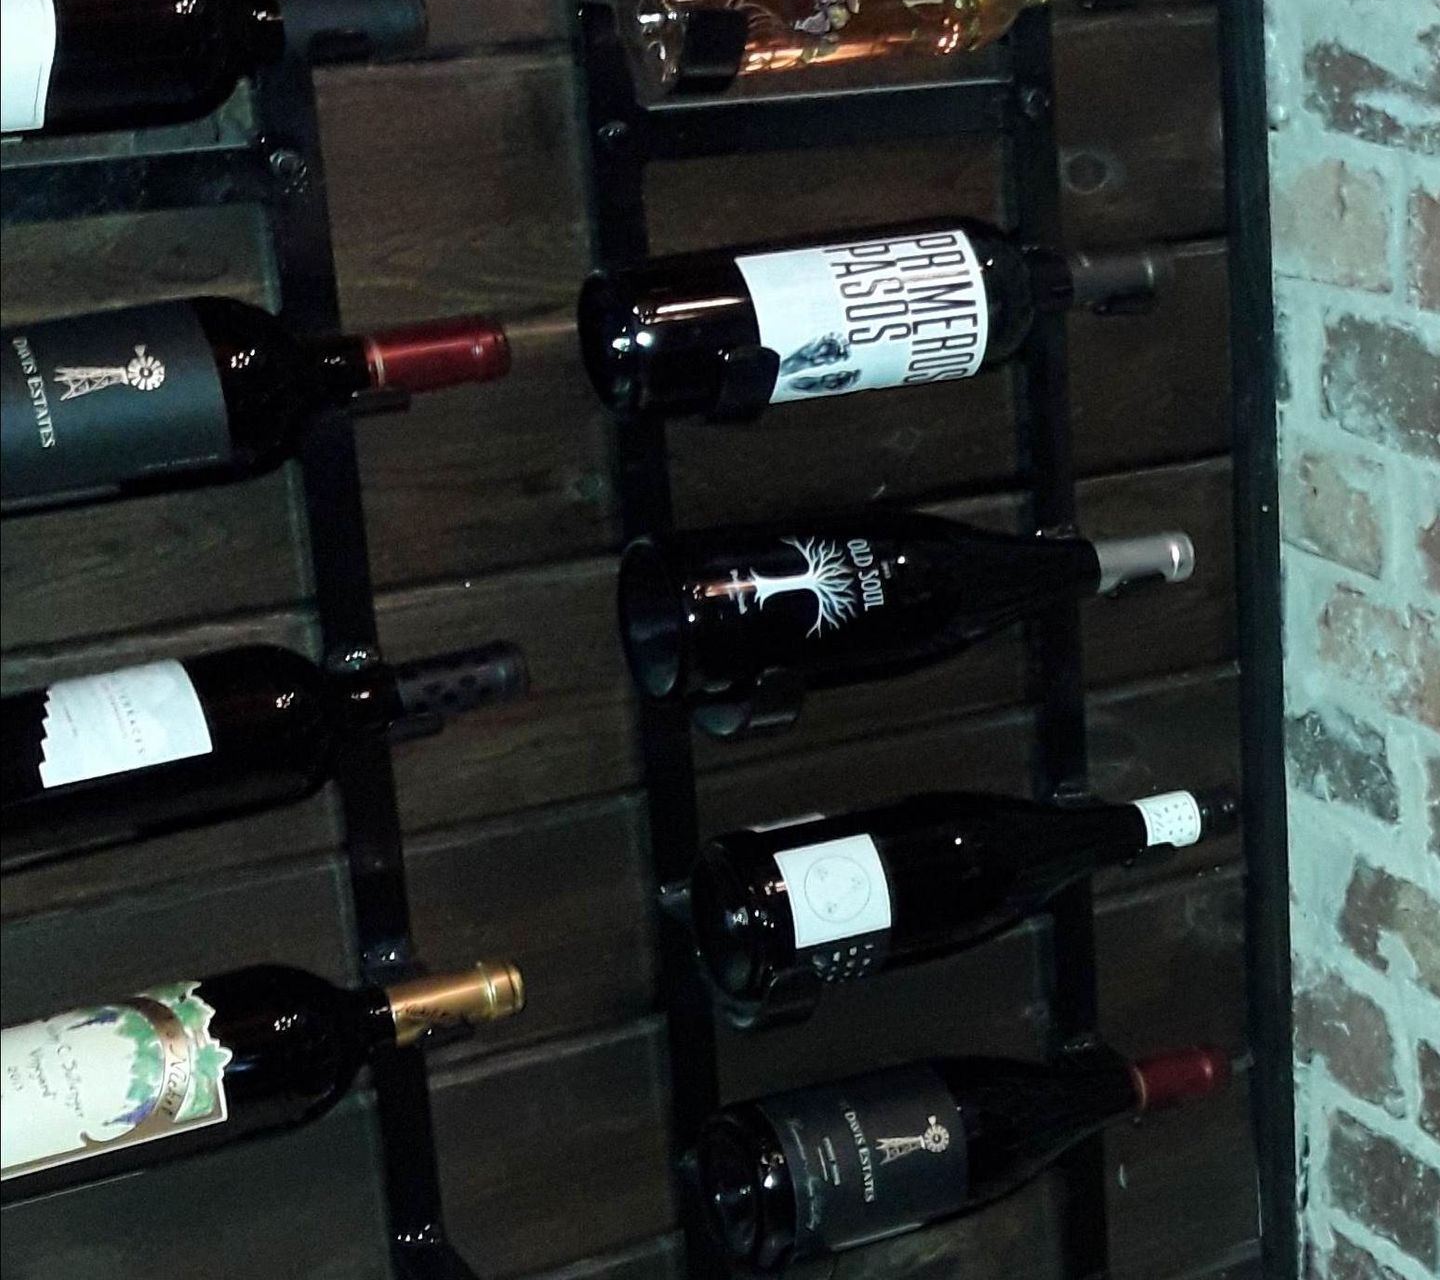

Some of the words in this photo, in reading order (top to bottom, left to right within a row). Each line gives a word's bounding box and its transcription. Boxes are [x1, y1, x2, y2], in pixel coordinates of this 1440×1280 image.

[823, 242, 912, 346] PASOS
[891, 234, 978, 384] PRIMEROS
[847, 537, 874, 568] OLD
[857, 568, 885, 612] SOUL
